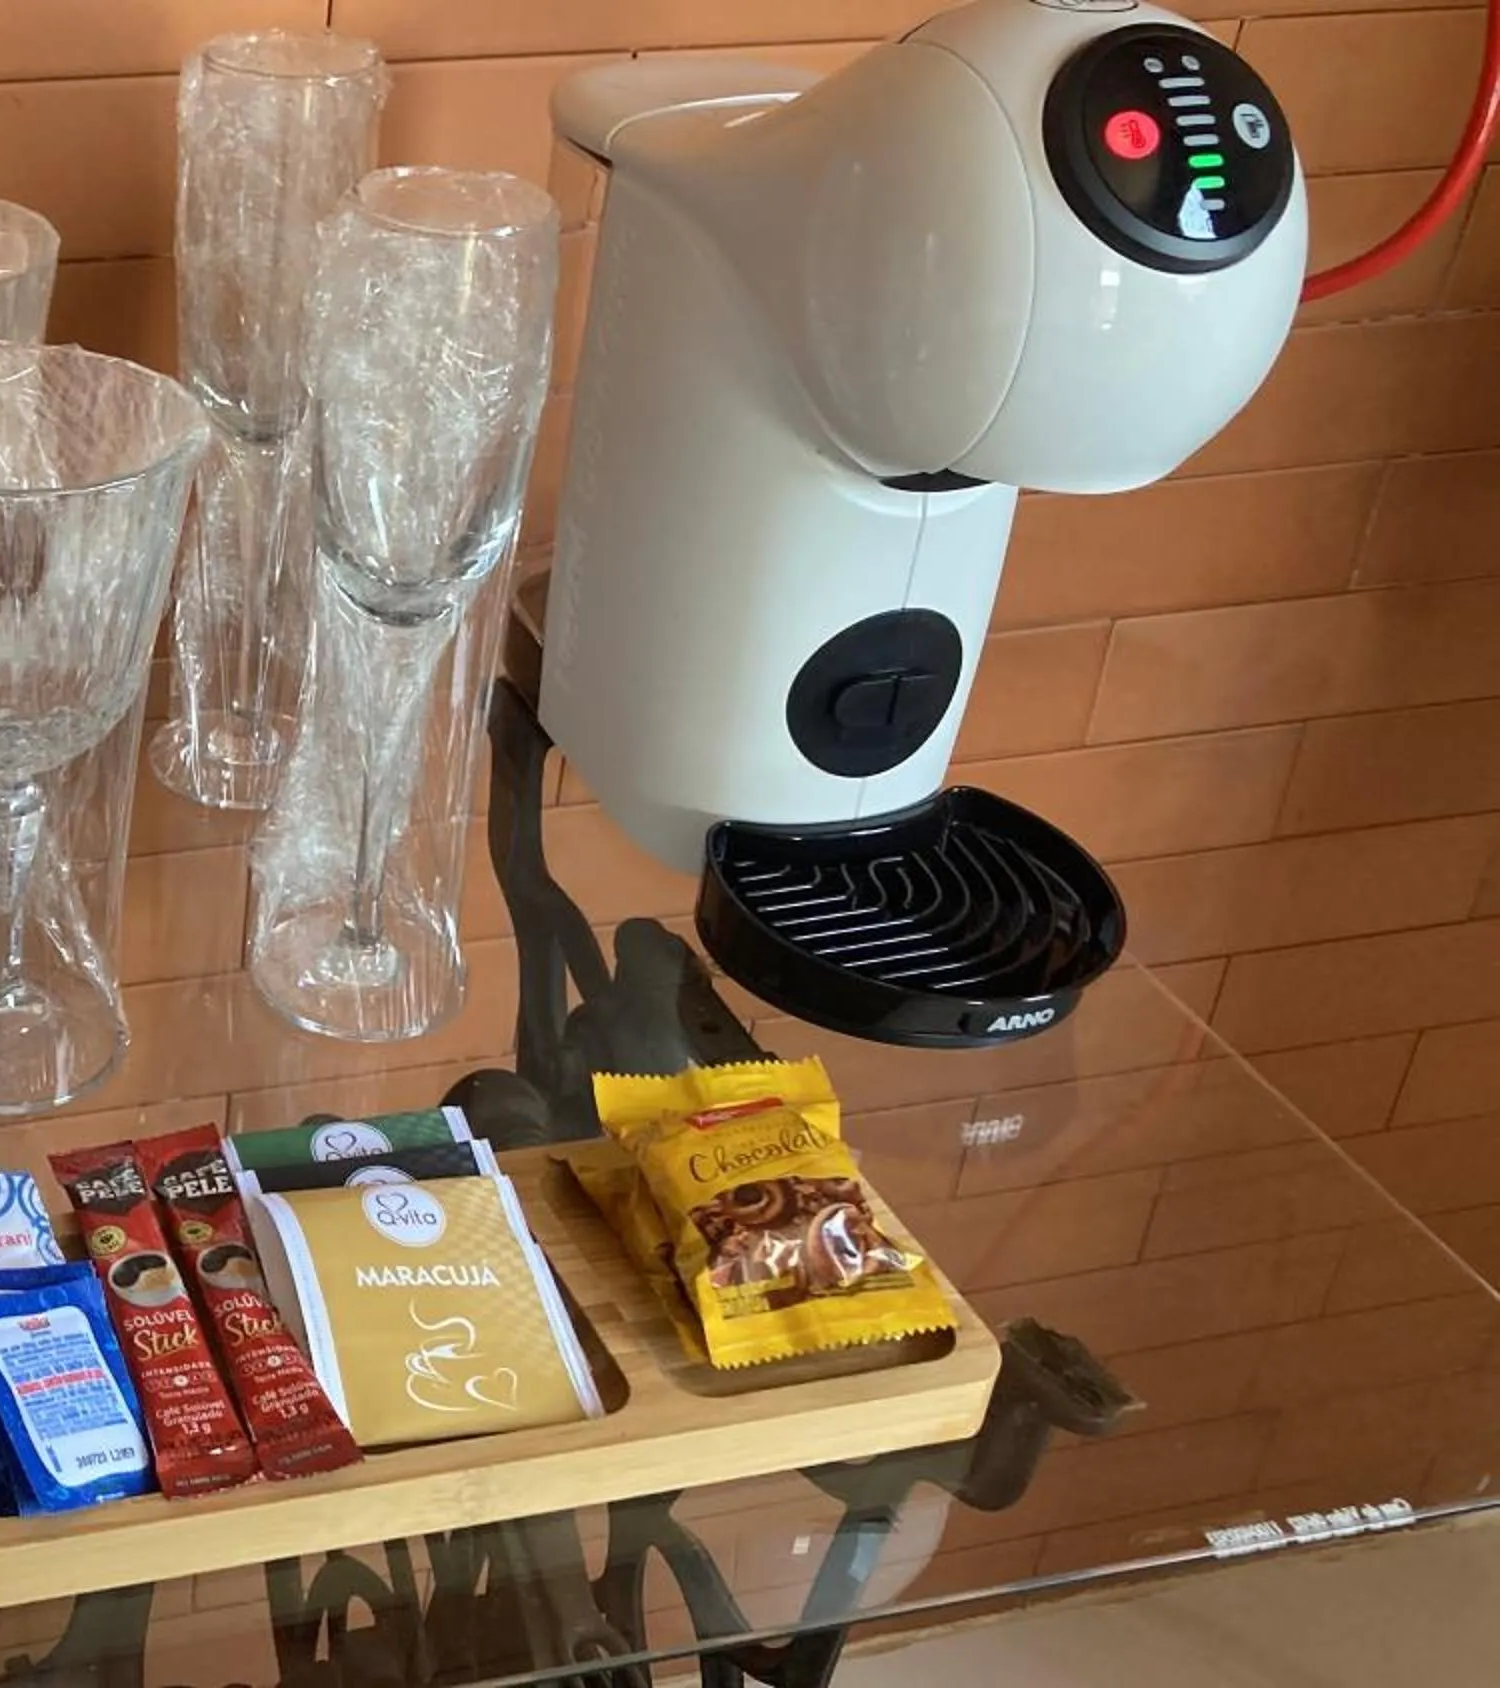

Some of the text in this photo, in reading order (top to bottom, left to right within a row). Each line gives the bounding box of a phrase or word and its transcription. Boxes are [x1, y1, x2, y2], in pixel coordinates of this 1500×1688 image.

[986, 1007, 1055, 1032] ARNO
[355, 1258, 500, 1288] MARACUJÁ
[123, 1309, 196, 1332] SOLÚVEL
[133, 1323, 198, 1361] Stick
